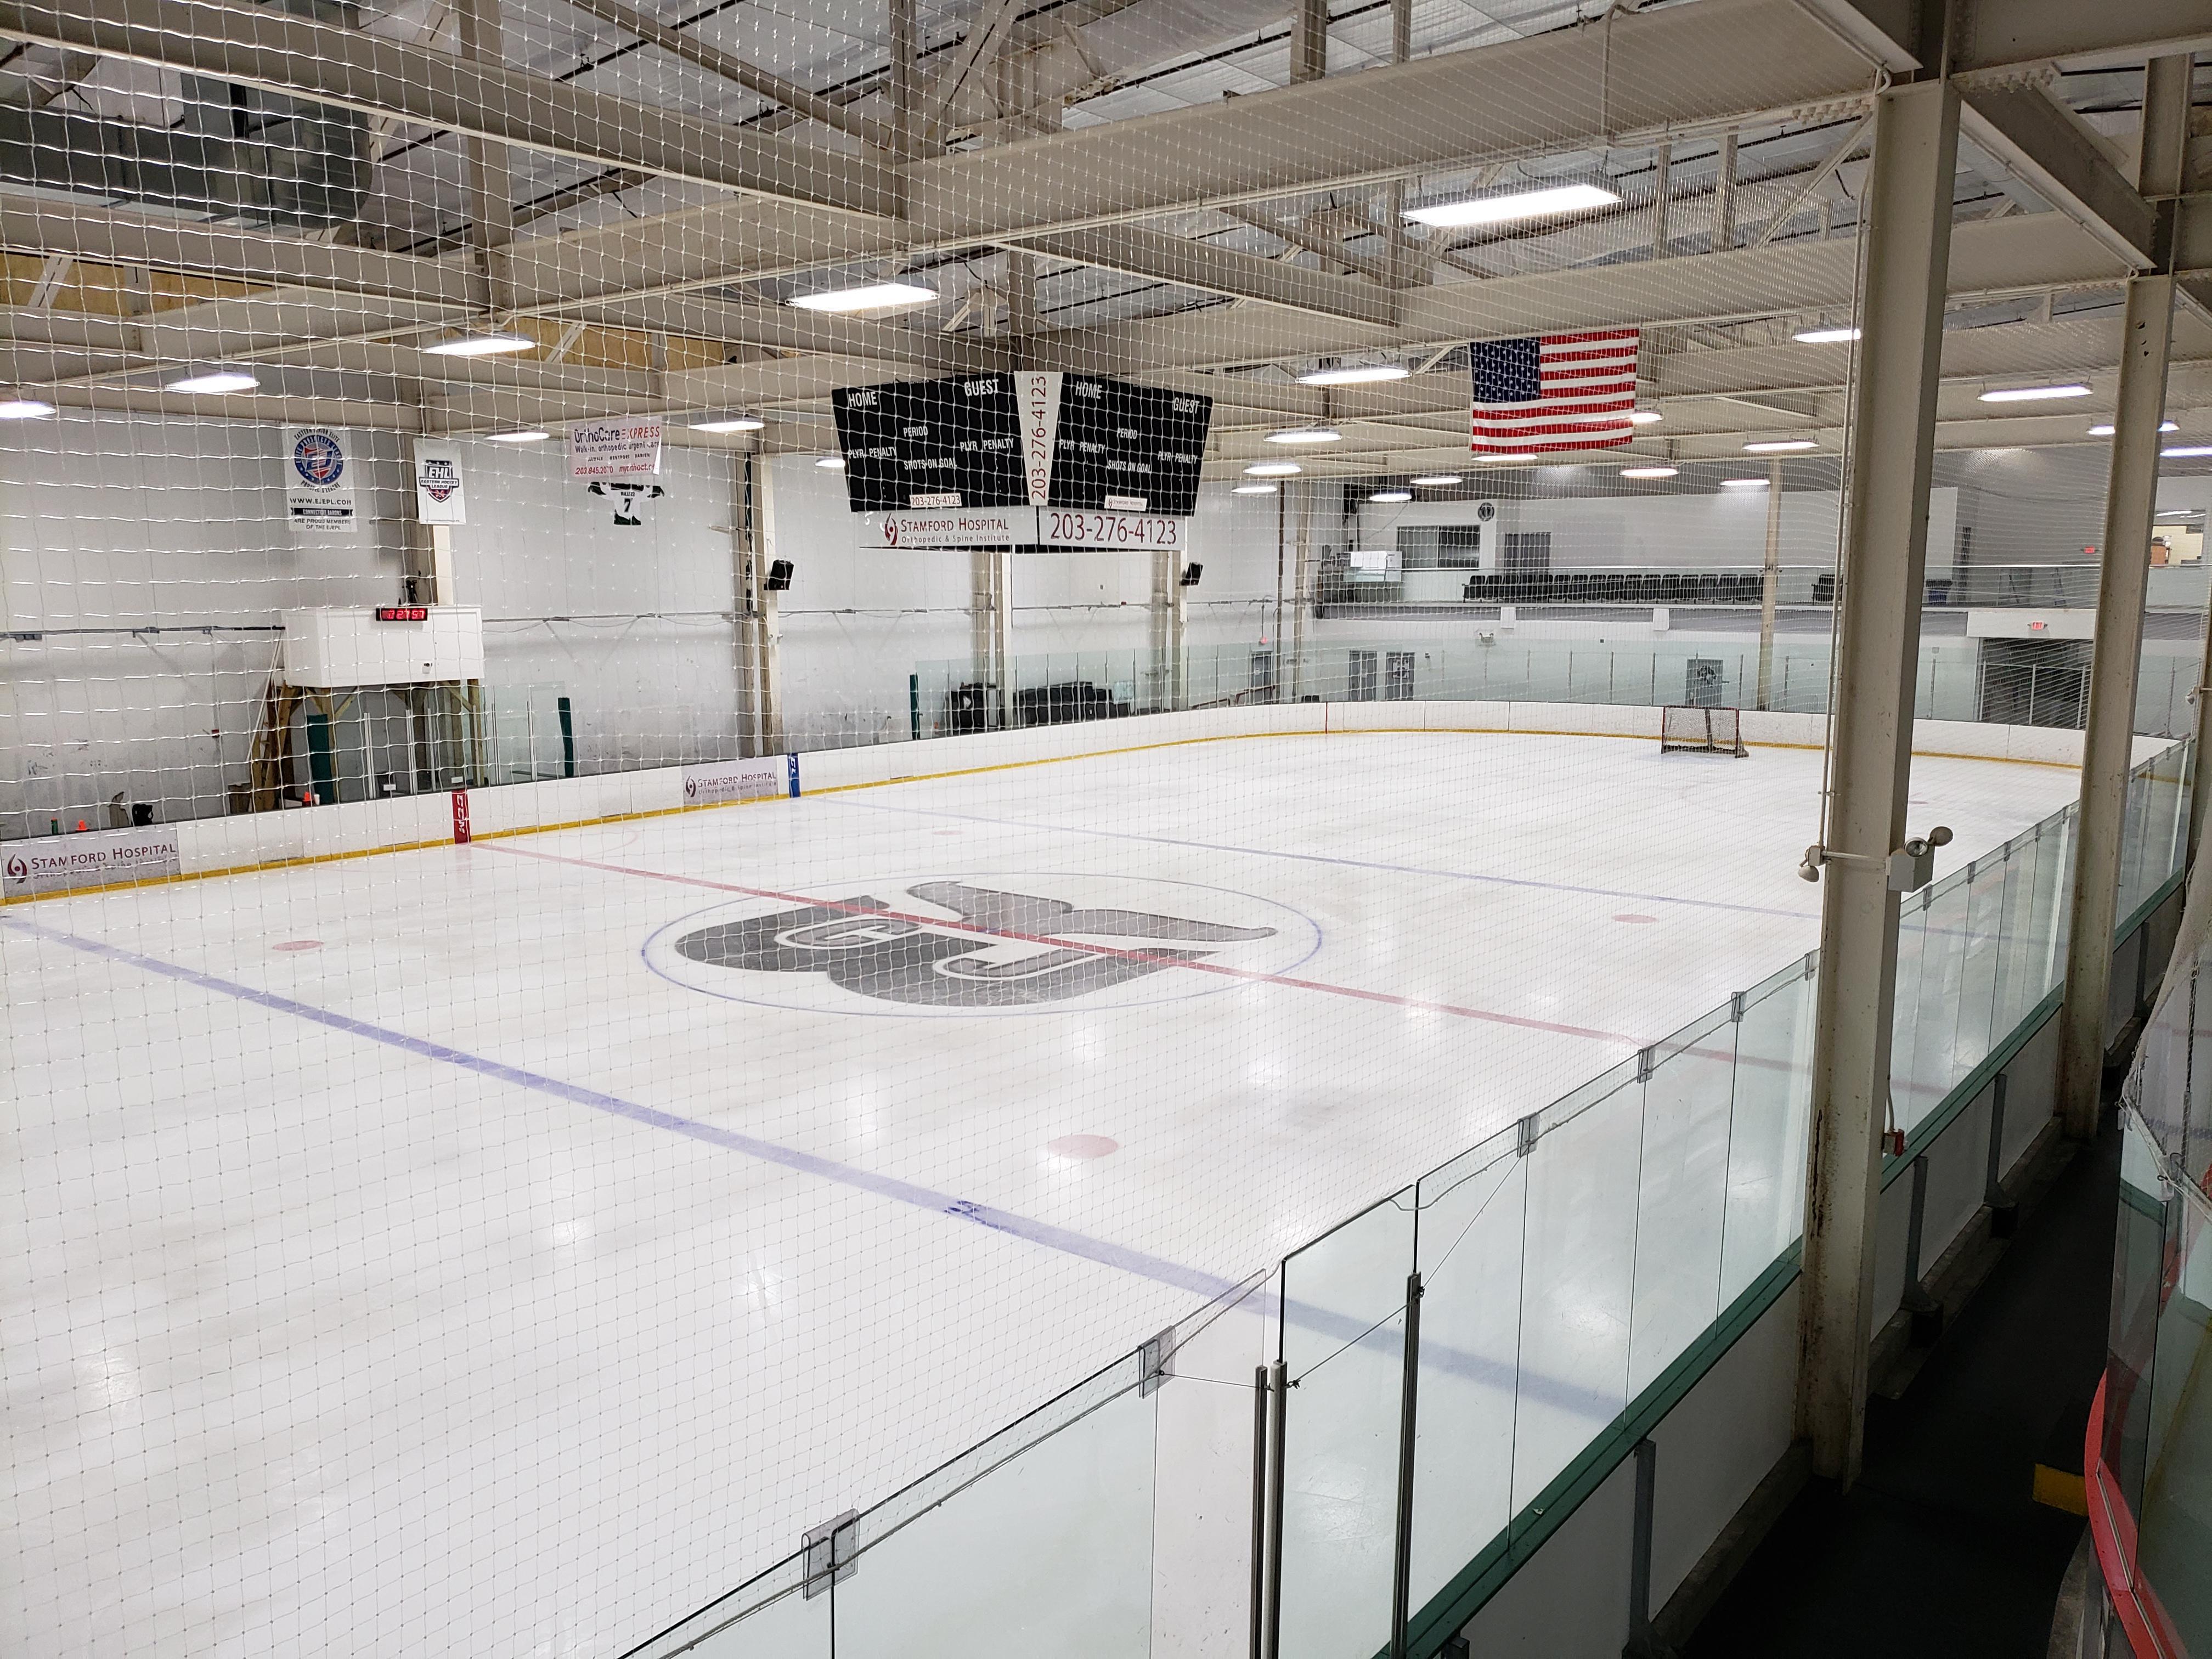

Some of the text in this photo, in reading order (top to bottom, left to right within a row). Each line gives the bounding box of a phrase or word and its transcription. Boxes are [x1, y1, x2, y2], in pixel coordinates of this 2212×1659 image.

[964, 379, 998, 397] GUEST
[1075, 381, 1102, 399] HOME
[848, 392, 877, 407] HOME
[1173, 397, 1200, 414] GUEST
[903, 426, 928, 437] PERIOD
[1031, 376, 1046, 499] 203-276-4123
[1117, 428, 1137, 439] PERIOD
[960, 438, 1014, 452] PLYR PENALTY
[1059, 439, 1105, 454] PLYR PENALTY
[848, 447, 897, 459] PLYR PENALTY
[1158, 451, 1198, 465] PLYR PENALTY
[904, 458, 957, 470] SHOTS ON GOAL
[1108, 460, 1152, 474] SHOTS ON GOAL
[428, 467, 450, 478] EHL
[624, 498, 633, 512] 7
[912, 495, 961, 506] 203-276-4123
[901, 517, 1009, 533] STAMFORD HOSPITAL
[1050, 512, 1177, 545] 203-276-4123
[901, 535, 941, 544] Orthopedic
[952, 535, 973, 543] Spine
[741, 772, 776, 782] HOSPITAL
[31, 852, 106, 870] STAMFORD
[112, 843, 176, 860] HOSPITAL
